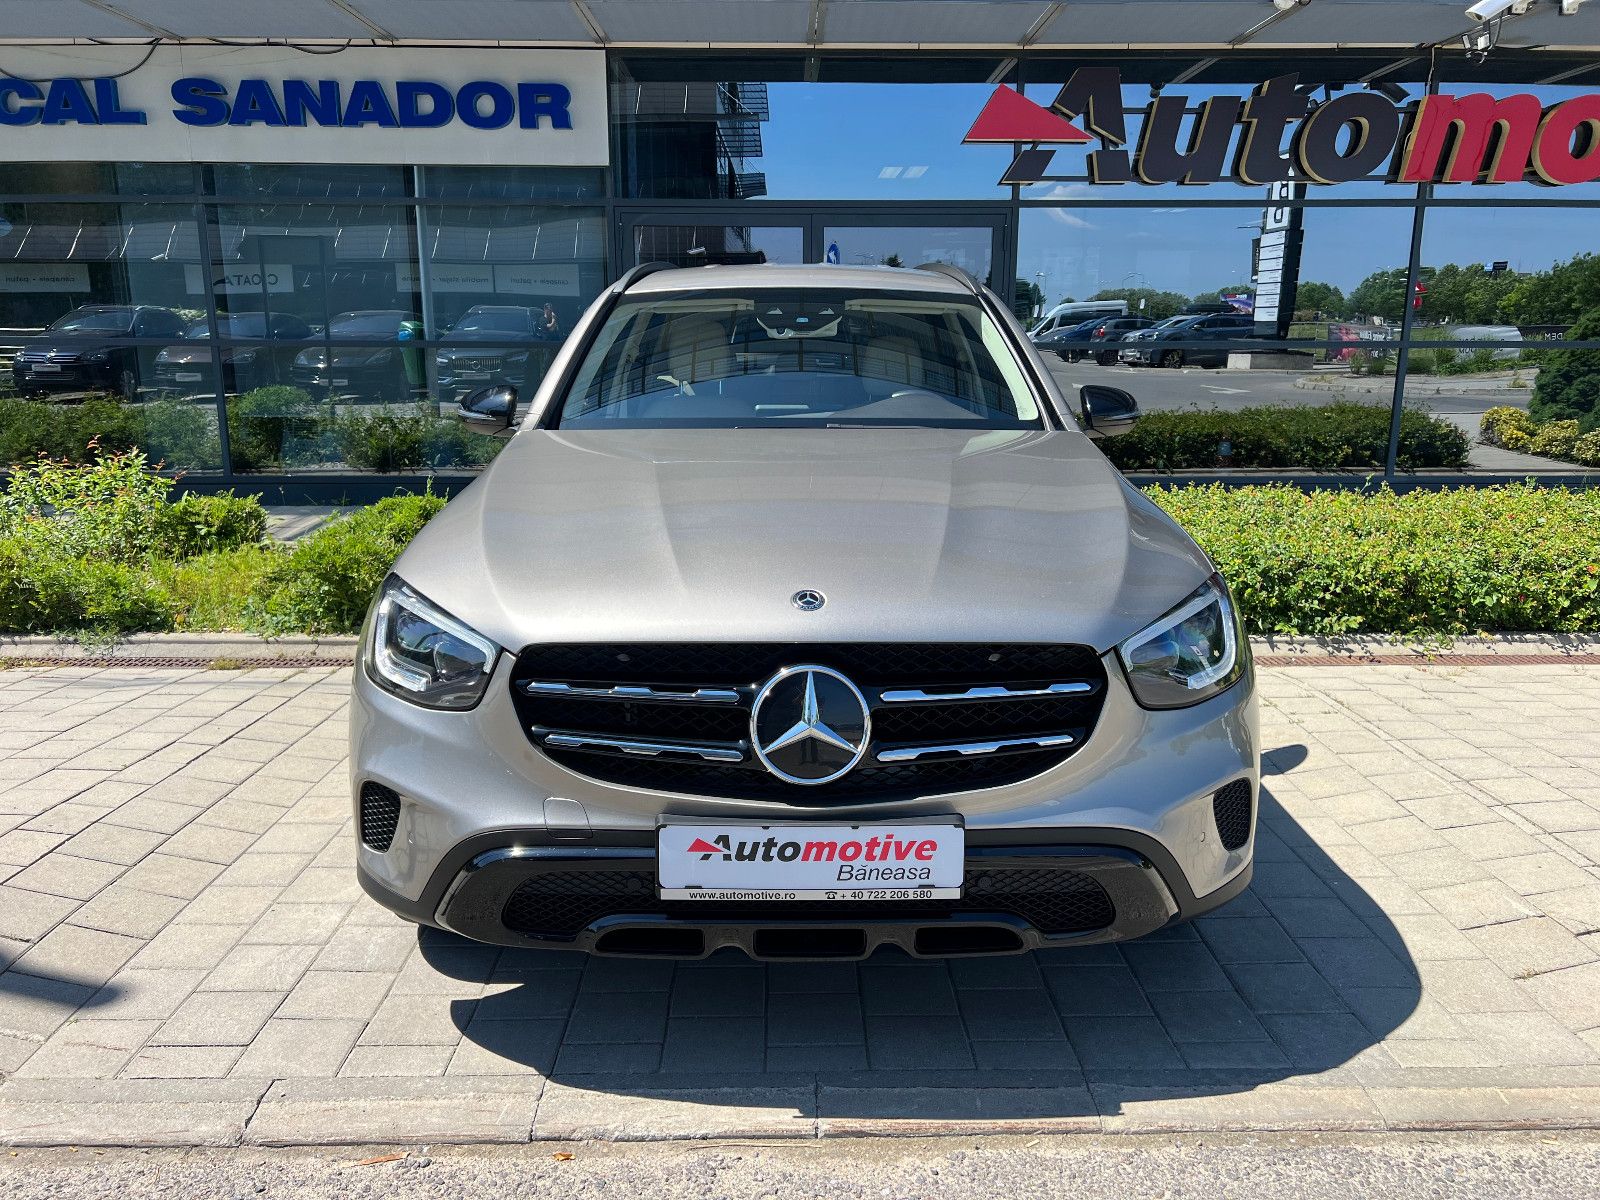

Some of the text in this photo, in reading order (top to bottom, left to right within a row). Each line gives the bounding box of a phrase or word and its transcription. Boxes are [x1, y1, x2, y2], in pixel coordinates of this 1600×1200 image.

[0, 77, 573, 130] CAL SANADOR
[998, 66, 1600, 186] Automo
[699, 834, 938, 863] Automotive
[836, 864, 931, 882] Băneasa
[689, 890, 796, 901] www.automotive.ro
[850, 890, 864, 900] 40
[867, 890, 888, 900] 722
[892, 890, 910, 900] 206
[912, 890, 933, 900] 580
